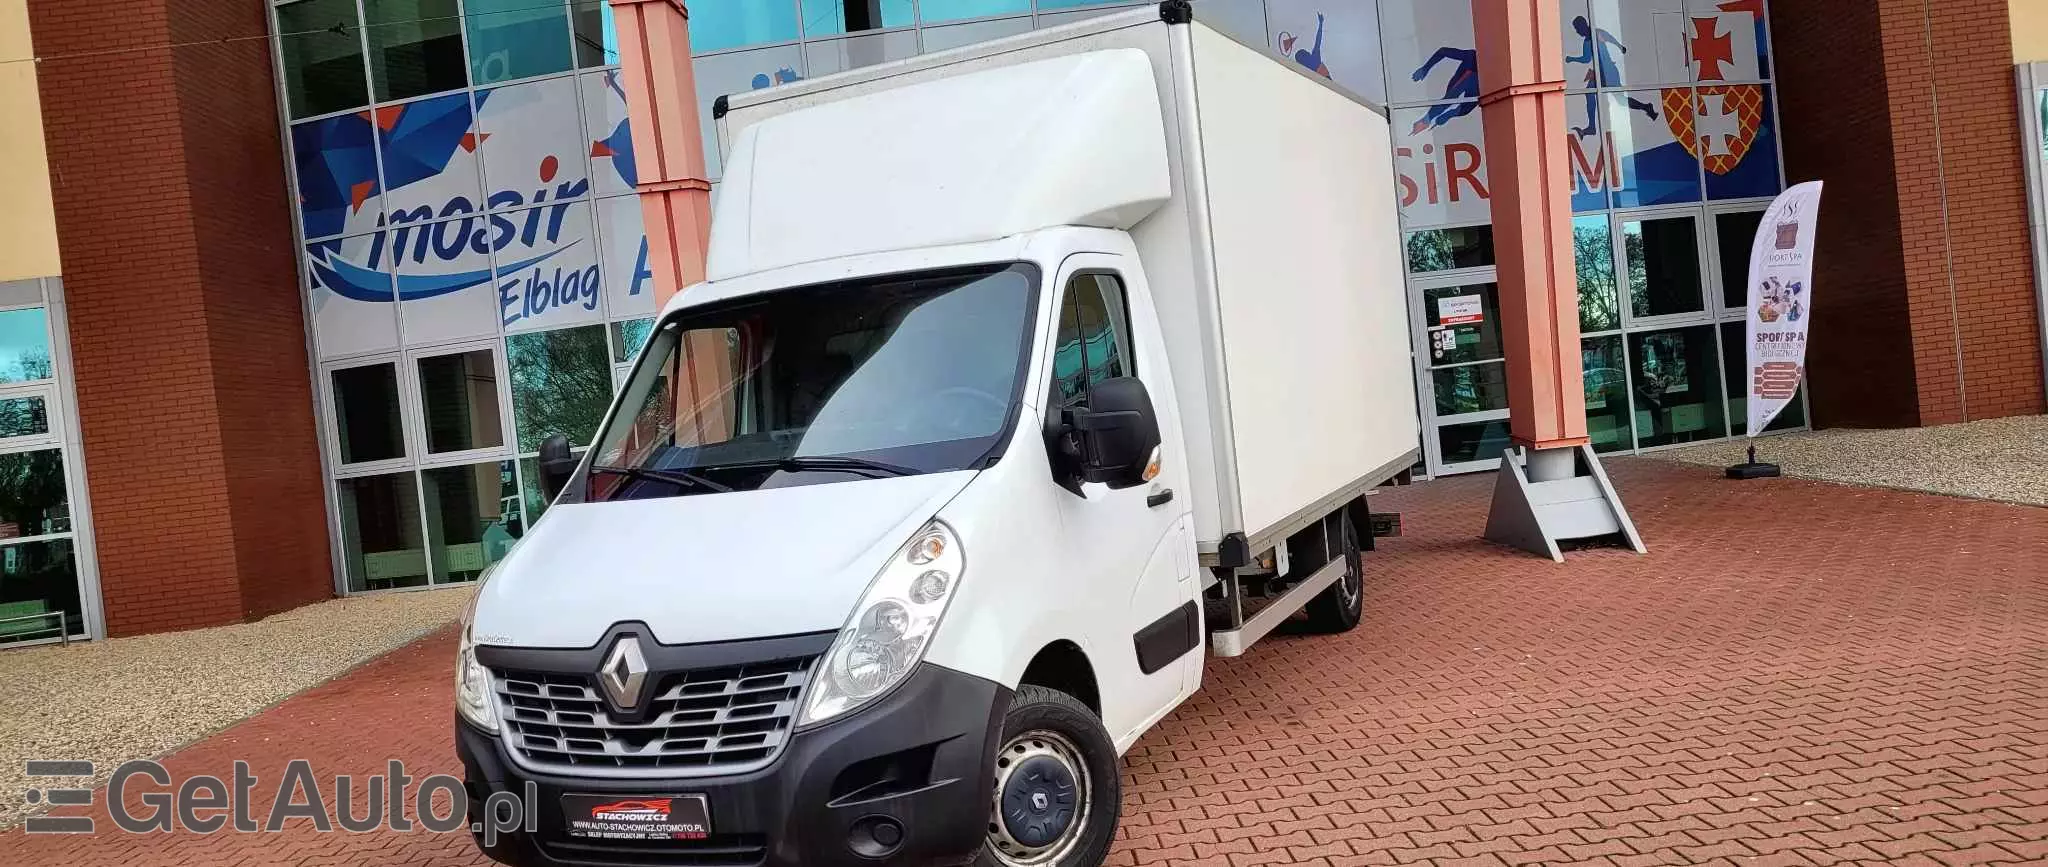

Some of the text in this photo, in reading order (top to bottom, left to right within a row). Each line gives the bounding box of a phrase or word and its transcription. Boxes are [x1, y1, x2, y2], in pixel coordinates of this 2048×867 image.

[368, 155, 589, 269] mosir
[596, 812, 669, 821] STACHOWICZ
[572, 820, 705, 832] WWW.AUTO-STACHOWICZ.OTOMOTO.PL
